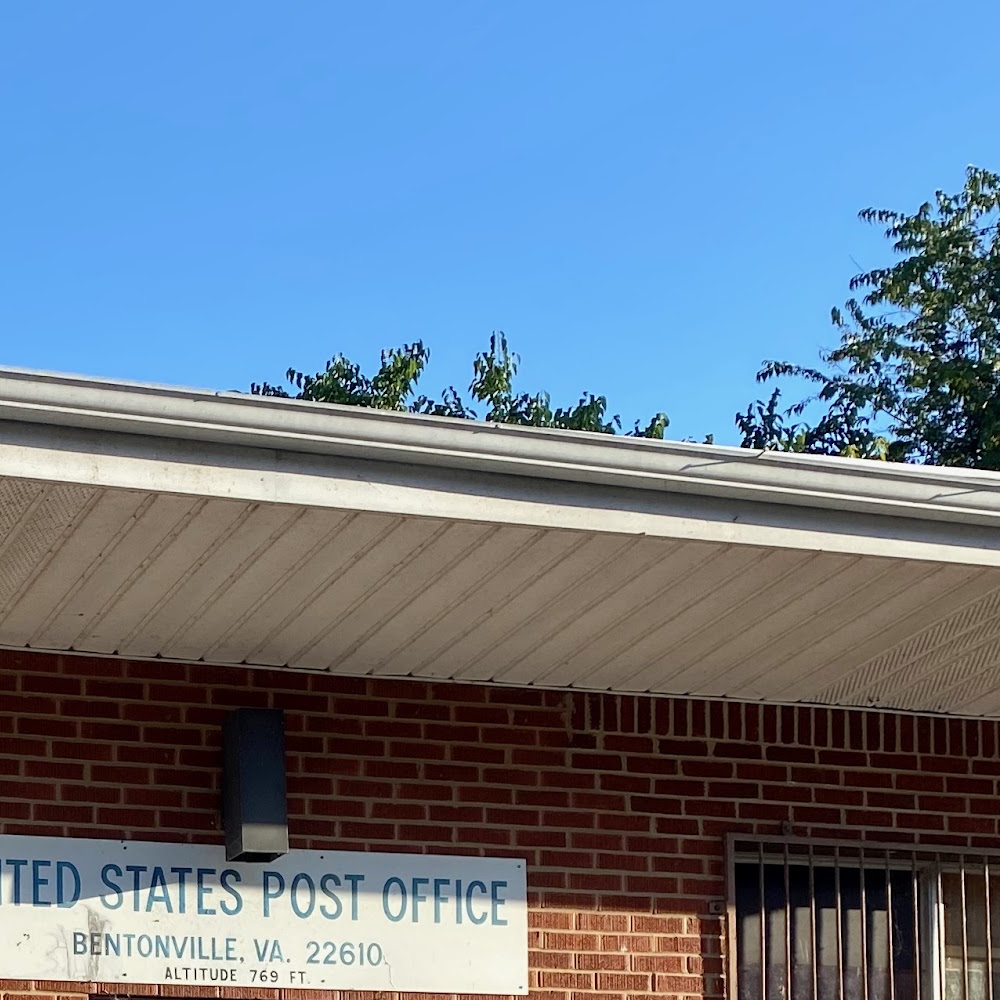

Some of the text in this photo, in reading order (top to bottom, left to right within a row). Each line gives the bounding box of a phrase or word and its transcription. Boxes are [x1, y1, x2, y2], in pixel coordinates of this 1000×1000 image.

[100, 863, 243, 916] STATES
[262, 870, 365, 921] POST
[382, 877, 508, 926] OFFICE
[73, 932, 383, 966] BENTONVILLE, VA. 22610
[164, 967, 311, 985] ALTITUDE 769 FT.
